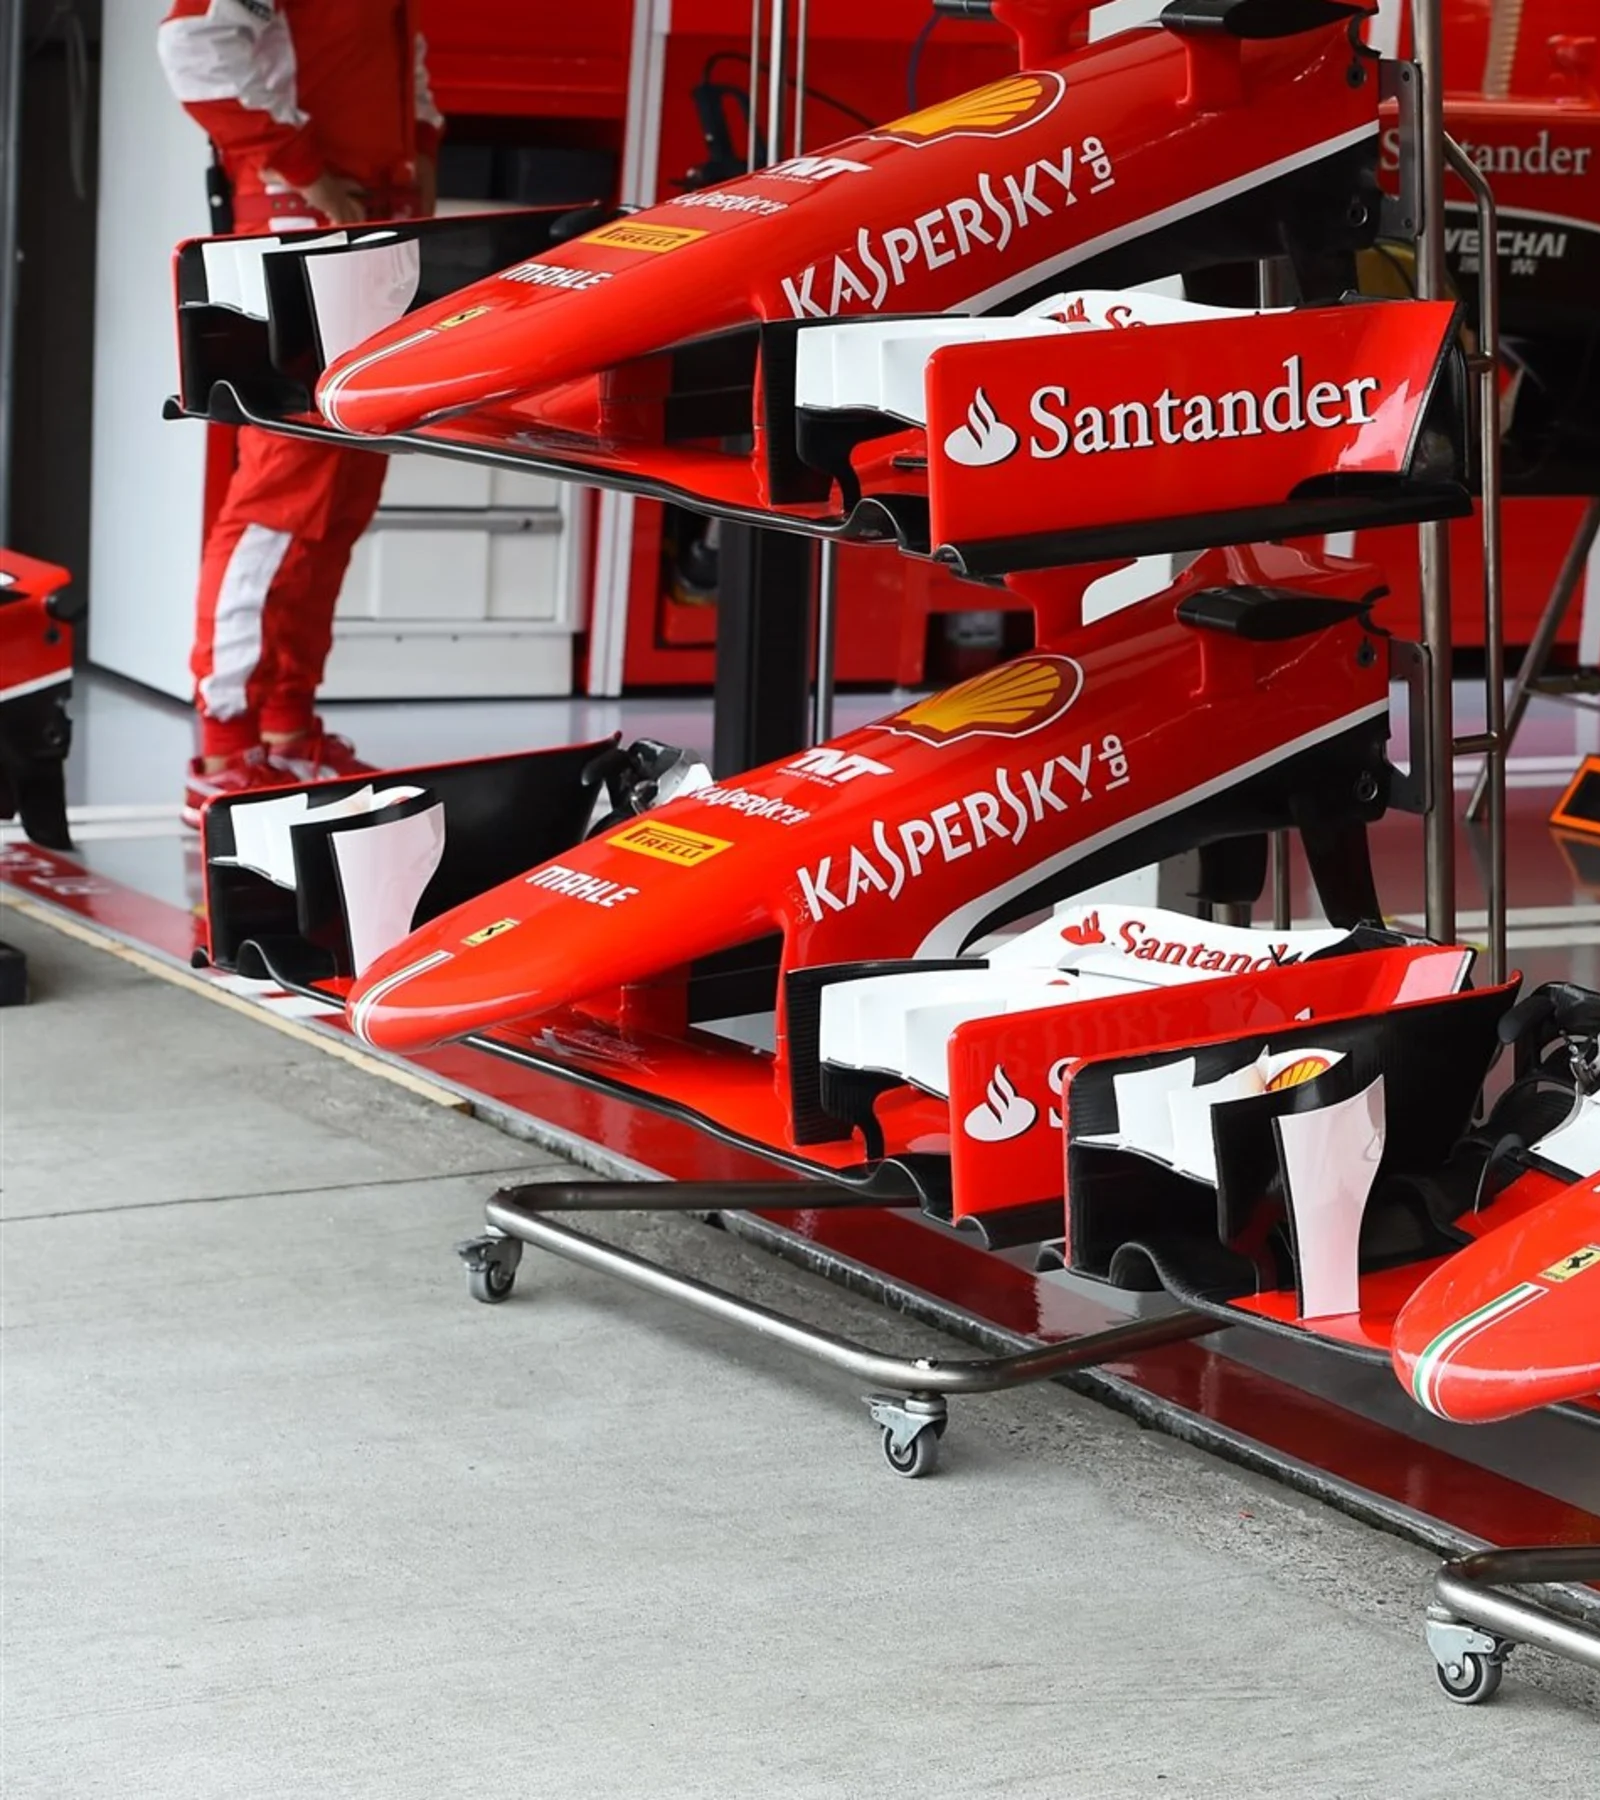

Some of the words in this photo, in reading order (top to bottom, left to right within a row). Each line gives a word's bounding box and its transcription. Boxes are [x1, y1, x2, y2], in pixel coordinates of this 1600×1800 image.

[762, 156, 873, 182] TNT
[1380, 129, 1591, 175] Sander
[597, 225, 690, 248] PIRELLI
[781, 145, 1078, 318] KASPERSKY
[1079, 136, 1116, 194] lab
[499, 263, 616, 291] MAHLE
[1029, 354, 1377, 461] Santander
[786, 747, 895, 783] TNT
[688, 786, 801, 824] KASPERSKY
[625, 826, 717, 860] PIRELLI
[797, 743, 1093, 922] KASPERSKY
[1098, 734, 1131, 791] lab
[525, 865, 642, 908] MAHLE
